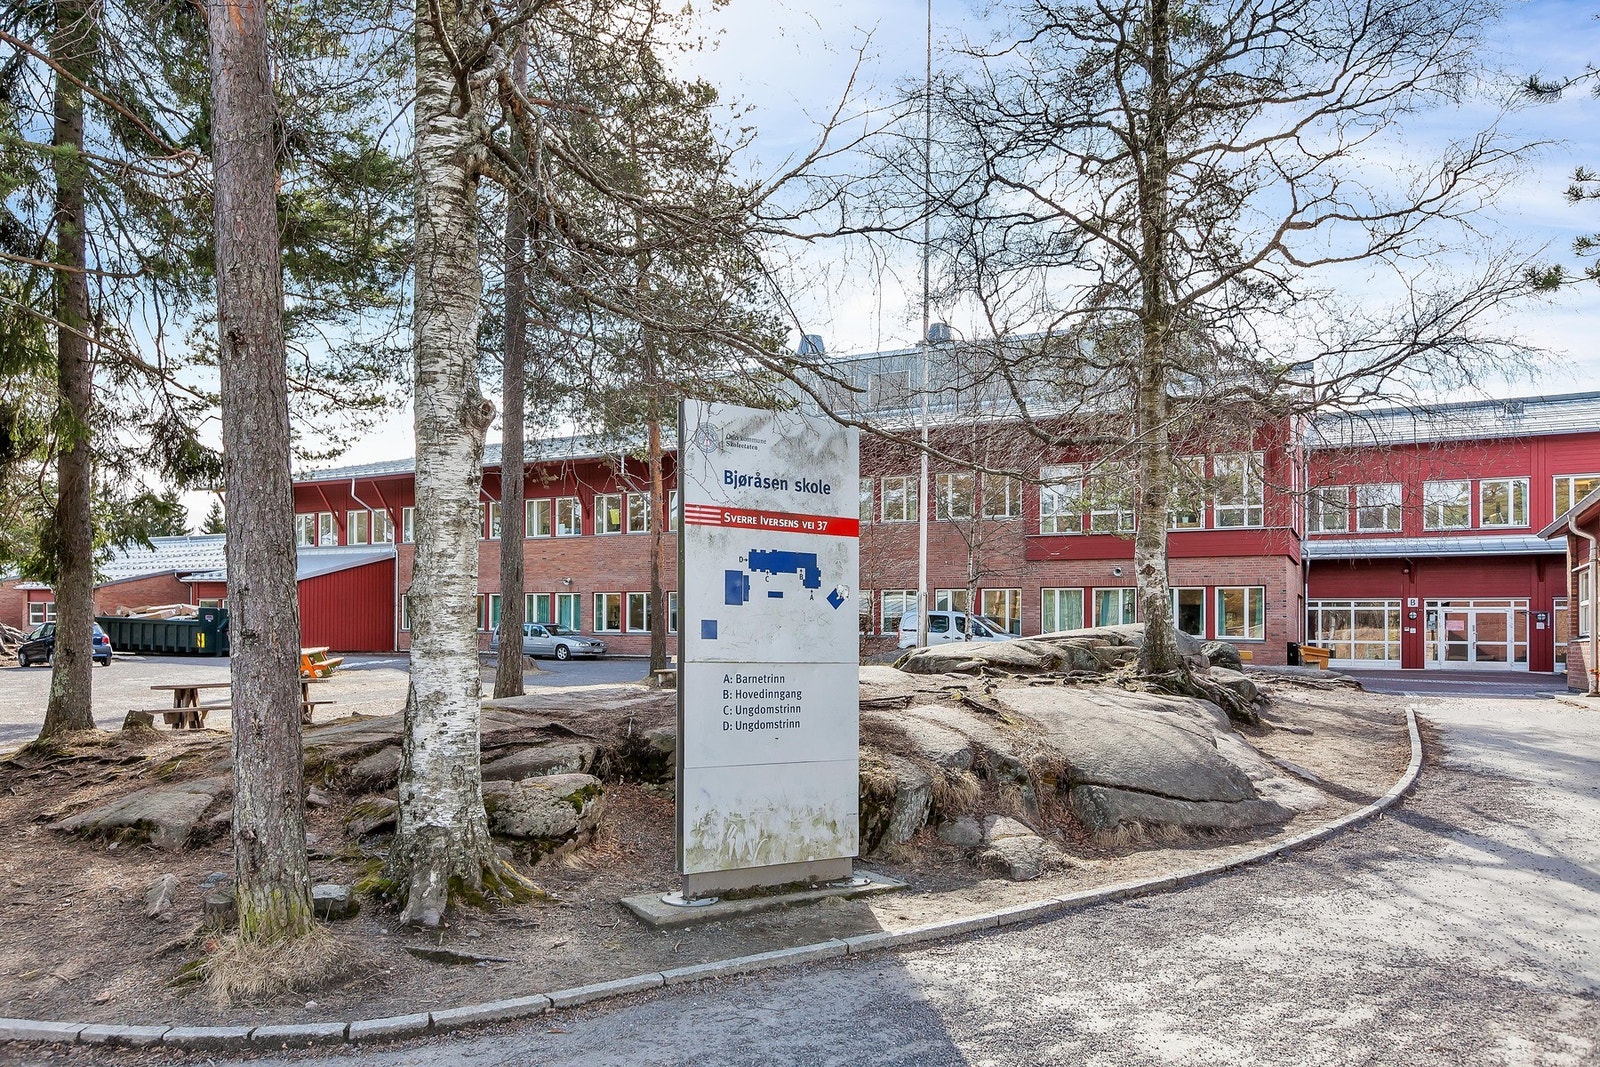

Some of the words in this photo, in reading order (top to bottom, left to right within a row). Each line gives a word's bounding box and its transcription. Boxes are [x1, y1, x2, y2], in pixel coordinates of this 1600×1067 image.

[724, 470, 788, 490] Bjøråsen
[794, 478, 830, 494] skole
[817, 520, 828, 530] 37
[723, 674, 733, 684] A:
[736, 674, 785, 684] Barnetrinn
[722, 690, 732, 700] B:
[736, 689, 802, 700] Hovedinngang
[723, 706, 732, 715] C:
[736, 704, 801, 716] Ungdomstrinn
[722, 721, 732, 730] D:
[736, 720, 800, 732] Ungdomstrinn
